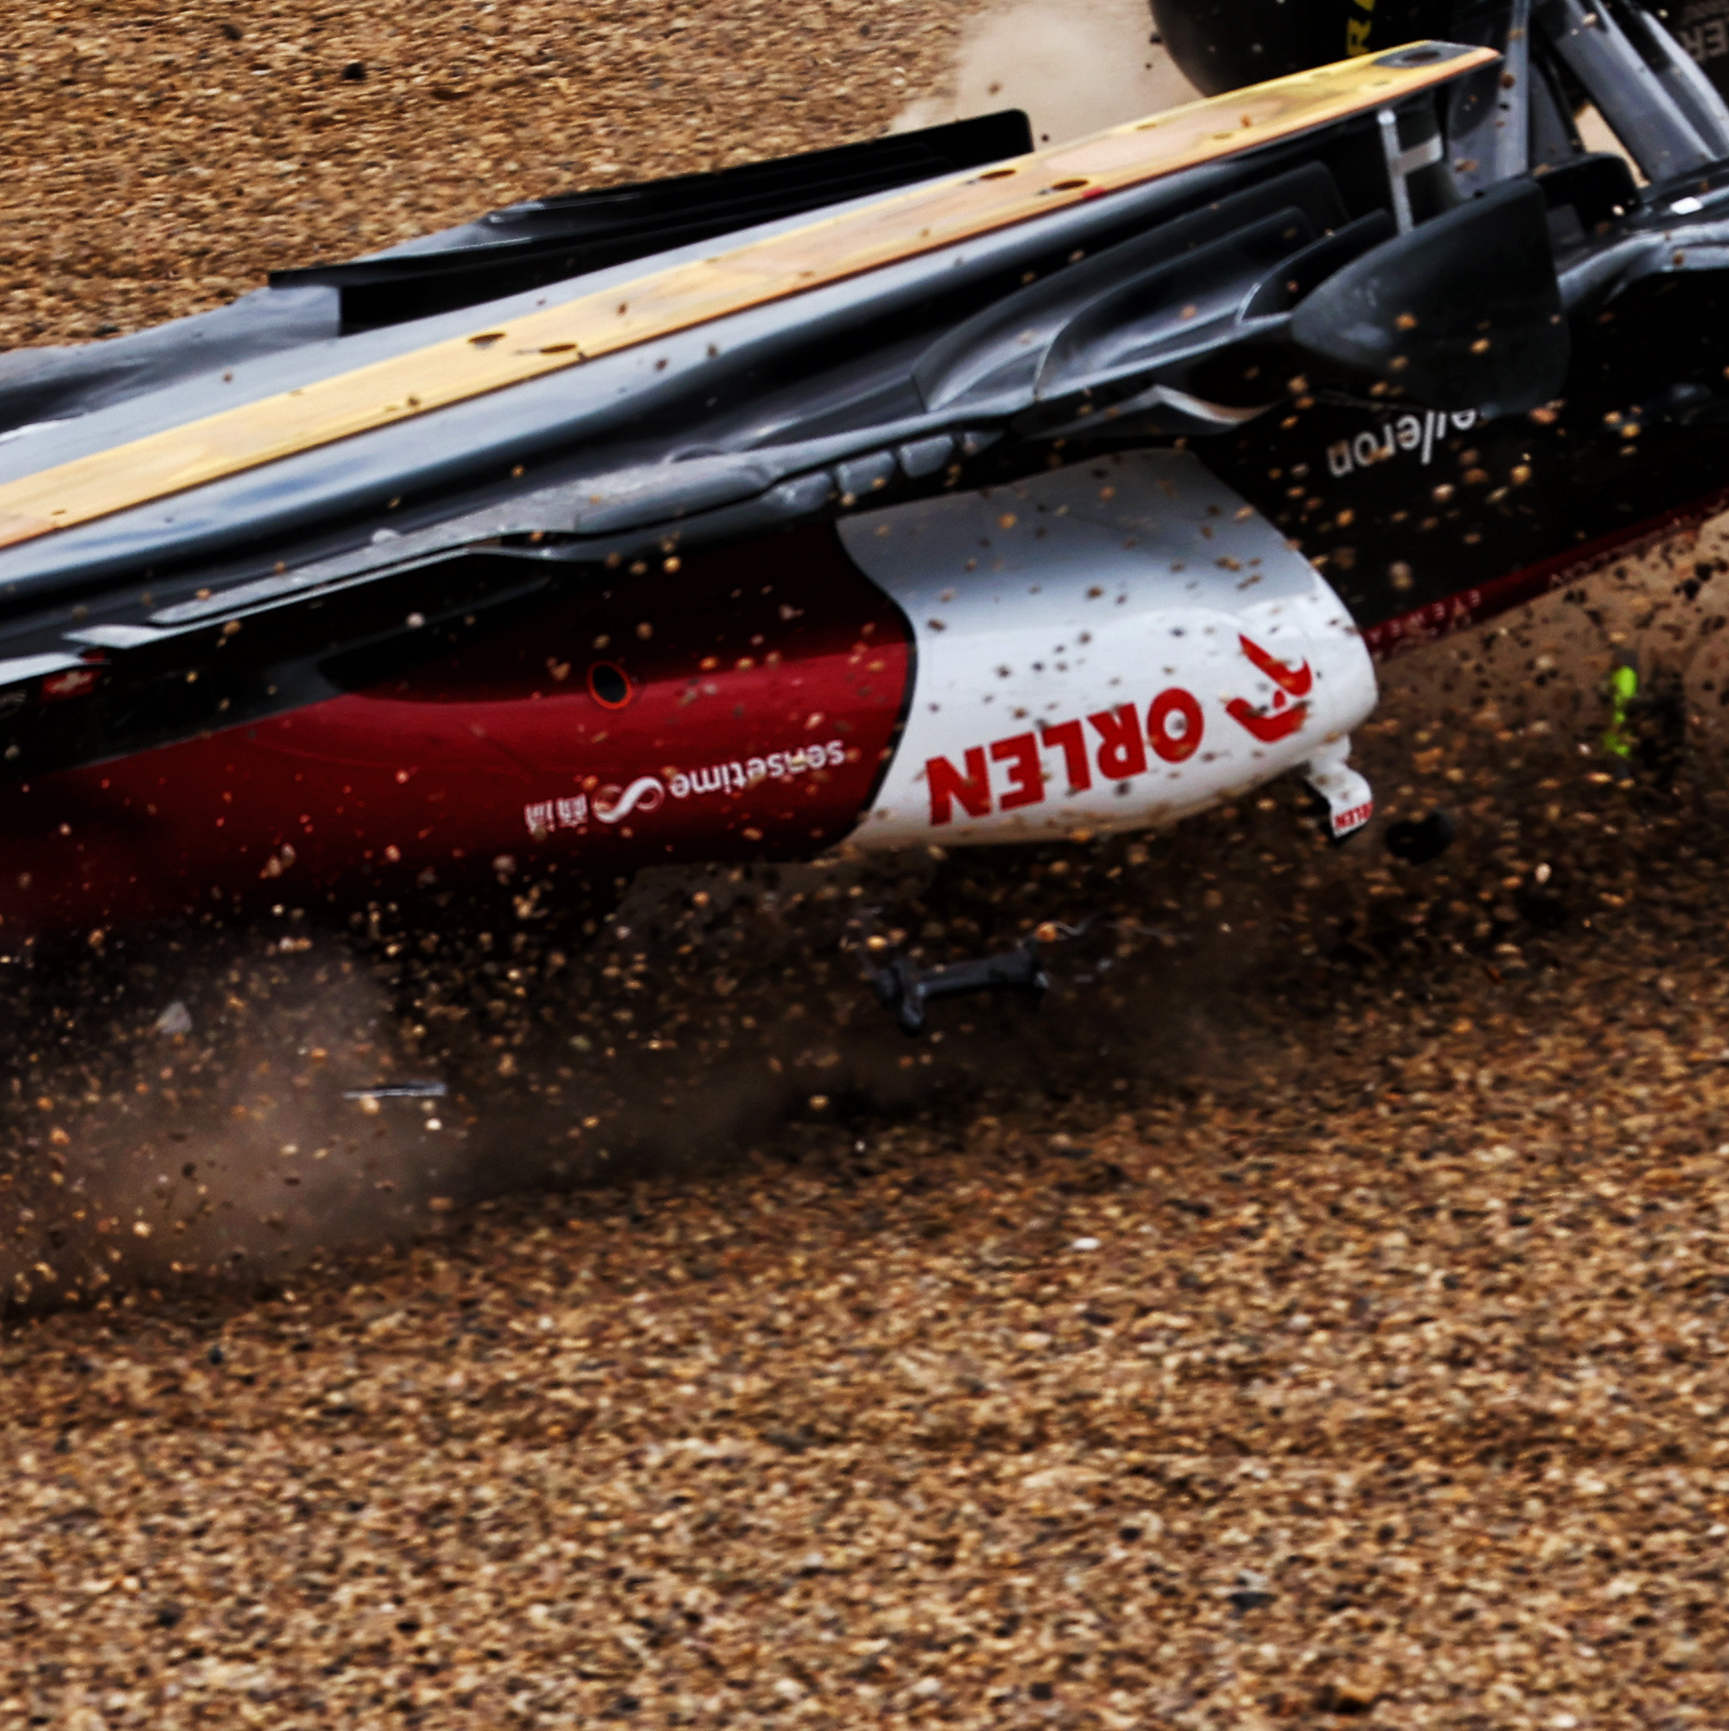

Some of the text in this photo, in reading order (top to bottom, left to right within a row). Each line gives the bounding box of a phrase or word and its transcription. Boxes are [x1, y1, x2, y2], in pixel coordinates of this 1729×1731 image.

[1328, 407, 1478, 476] elleron
[669, 739, 846, 801] sensetime
[925, 686, 1205, 826] ORLEN
